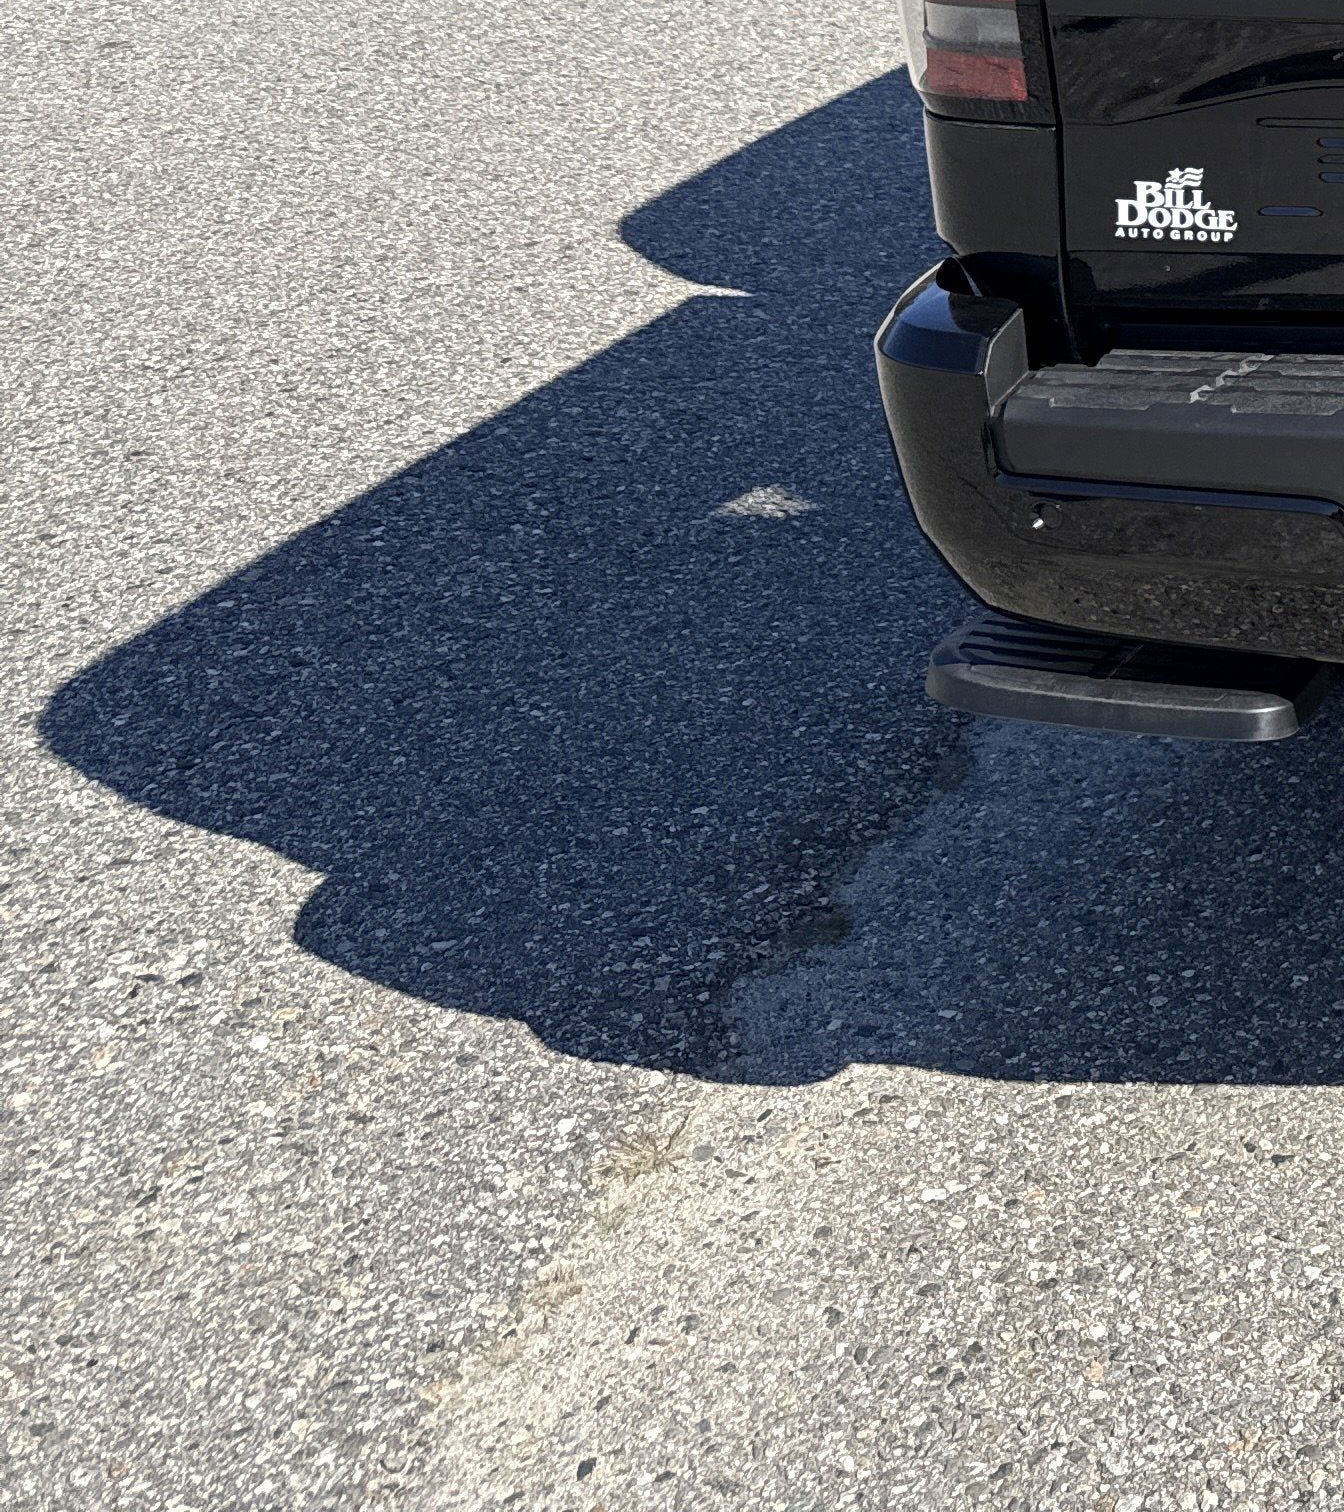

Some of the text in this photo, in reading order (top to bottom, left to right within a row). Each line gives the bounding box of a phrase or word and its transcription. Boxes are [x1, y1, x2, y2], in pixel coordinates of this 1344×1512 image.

[1133, 180, 1212, 210] BILL
[1115, 198, 1238, 231] DODGE
[1114, 226, 1234, 242] AUTO GROUP
